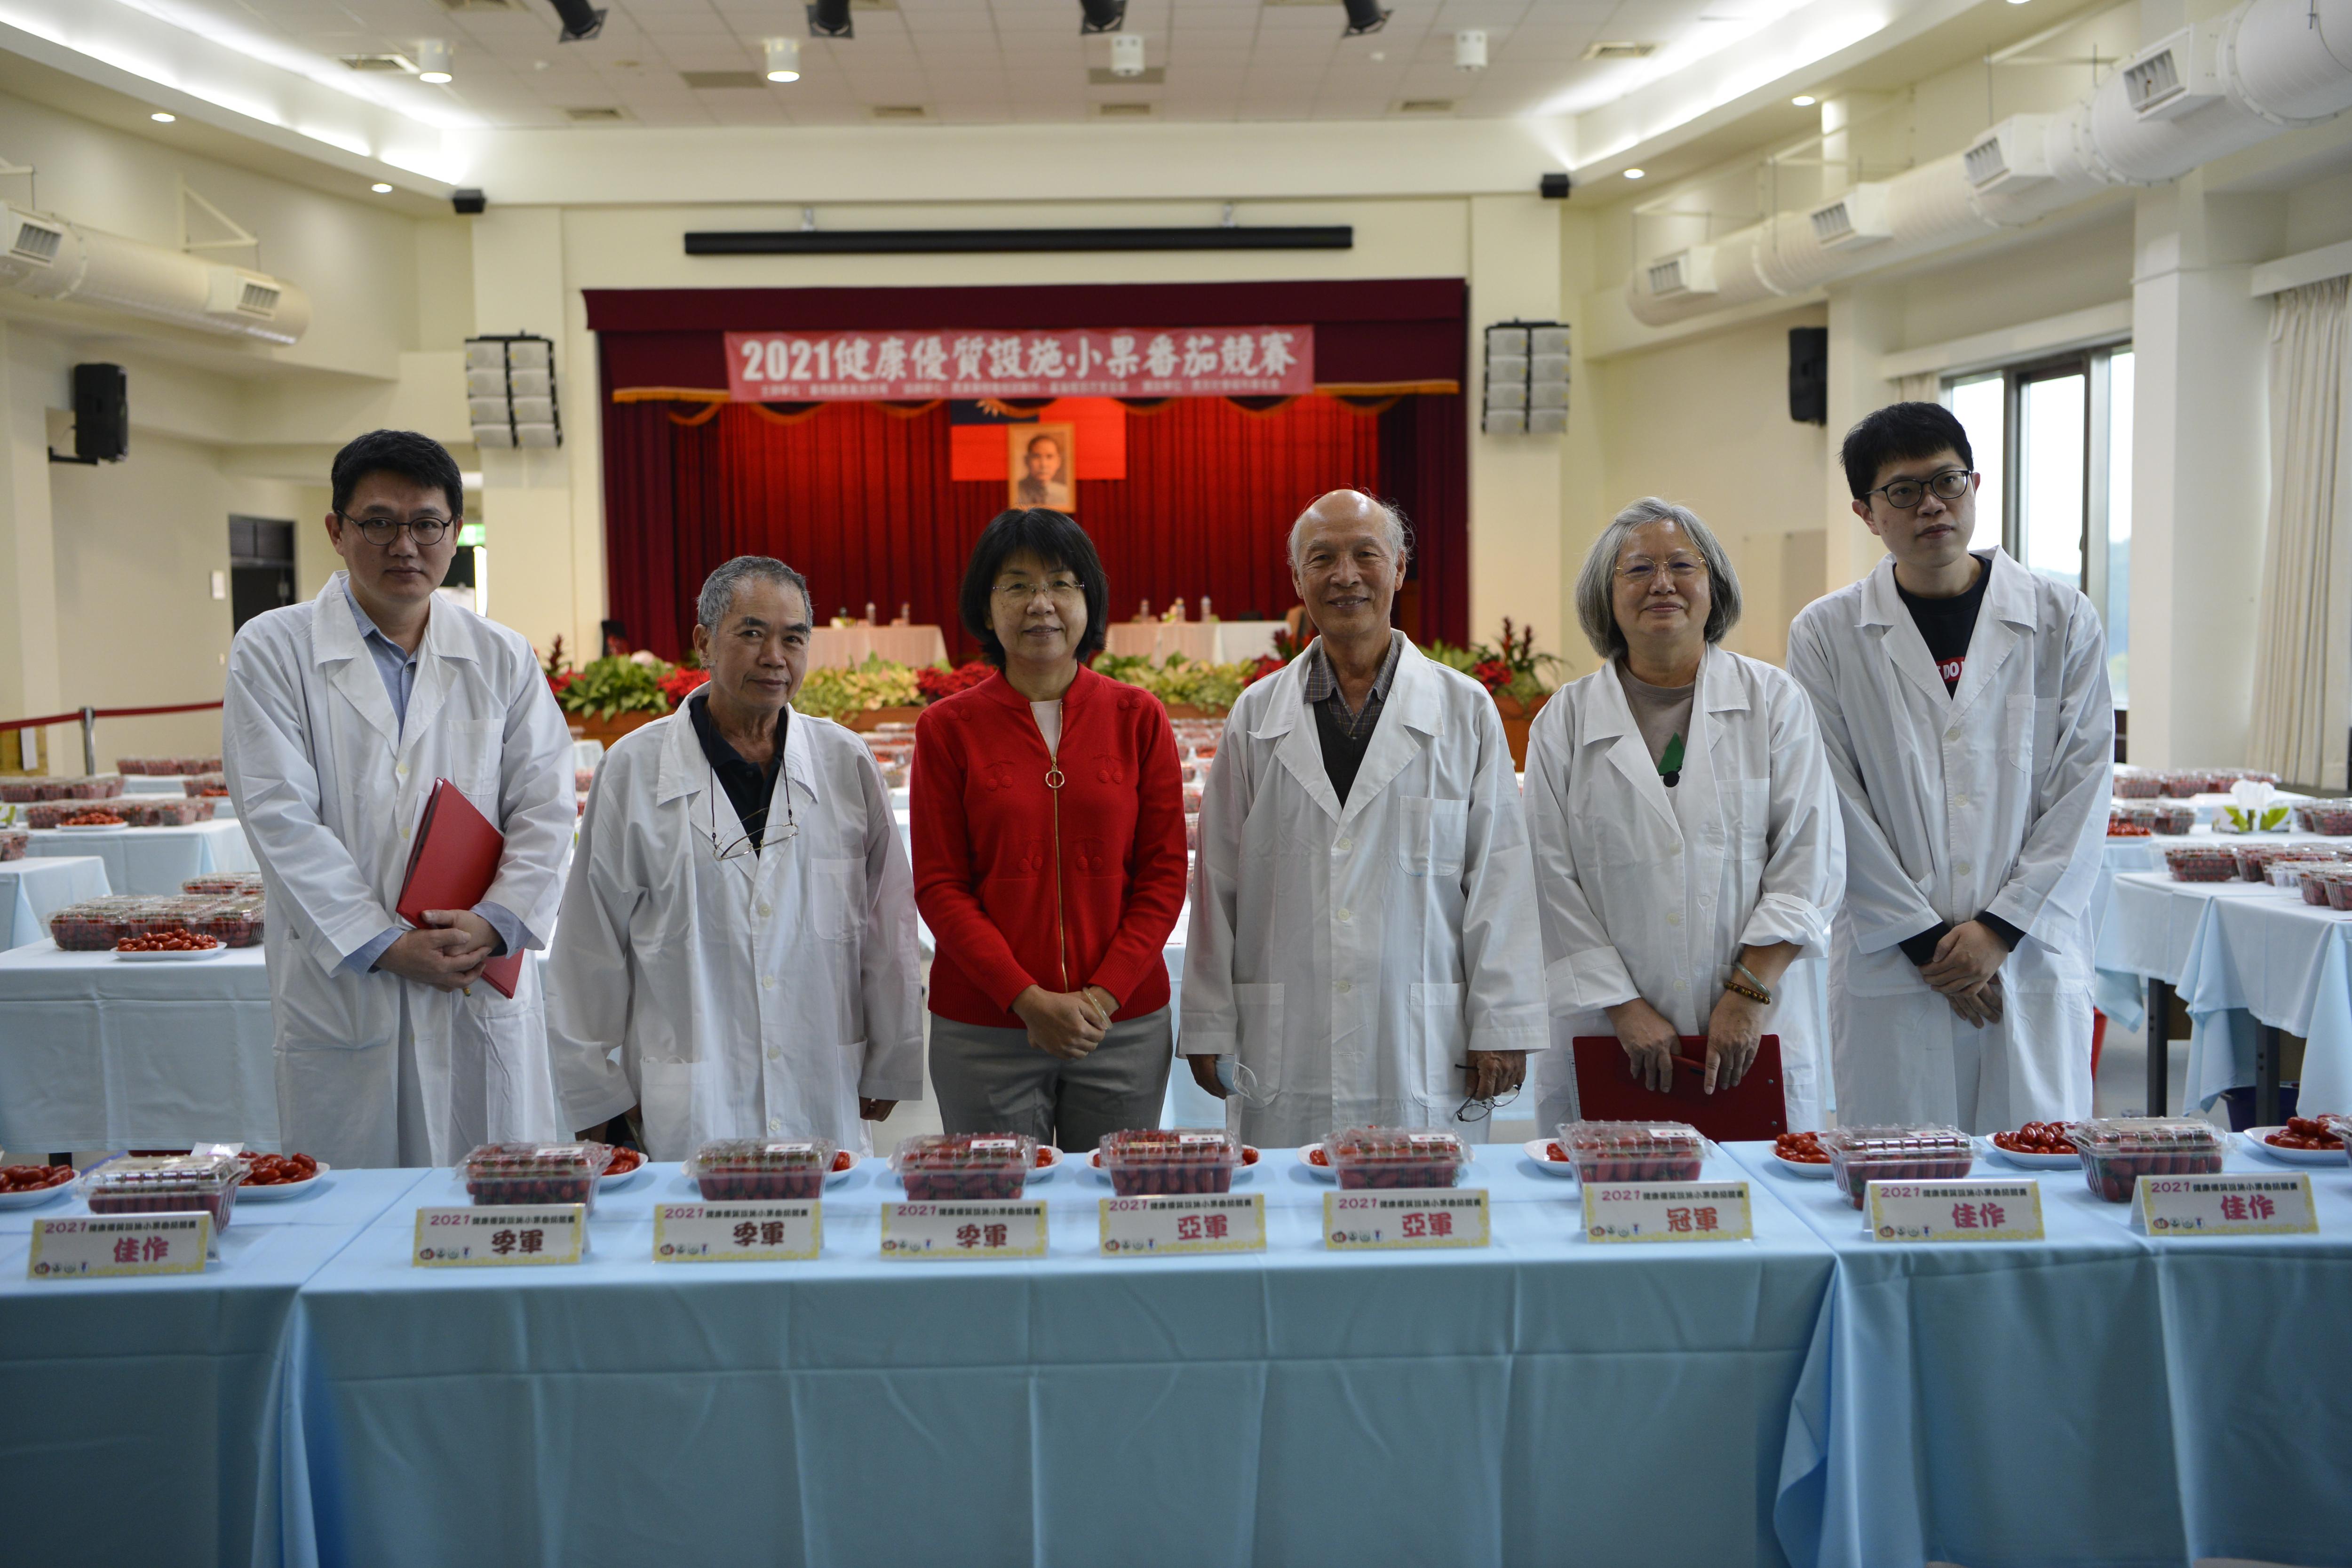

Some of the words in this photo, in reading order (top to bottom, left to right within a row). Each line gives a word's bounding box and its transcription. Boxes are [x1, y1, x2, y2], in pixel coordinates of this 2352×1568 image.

[1943, 661, 1959, 679] DO
[1666, 1206, 1718, 1232] 冠軍
[1952, 1202, 2005, 1228] 佳作
[2221, 1194, 2275, 1220] 佳作
[733, 1221, 785, 1246] 季軍
[956, 1224, 1007, 1248] 季軍
[1177, 1214, 1228, 1241] 亞軍
[1402, 1211, 1453, 1238] 亞軍
[113, 1236, 169, 1263] 佳作
[491, 1229, 544, 1254] 季軍
